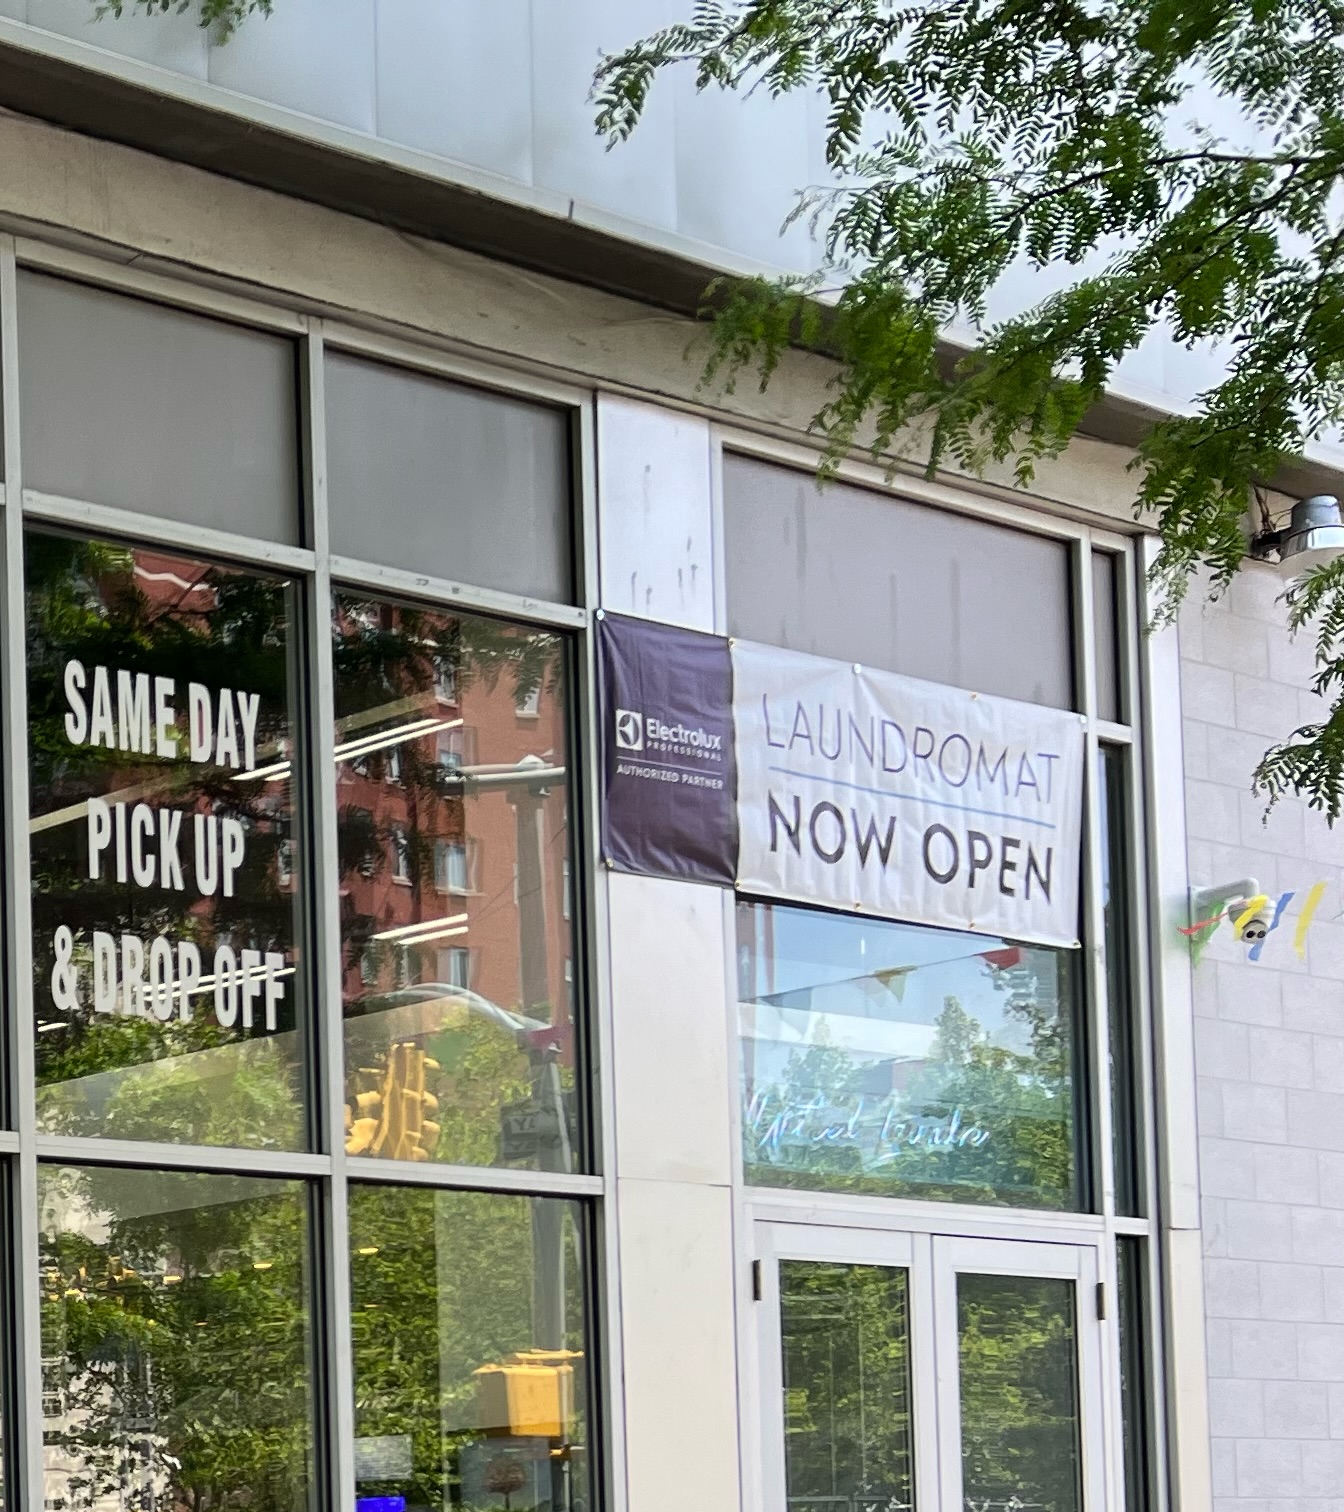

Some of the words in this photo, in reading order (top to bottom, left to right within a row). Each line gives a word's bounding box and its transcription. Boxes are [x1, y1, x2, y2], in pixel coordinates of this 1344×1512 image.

[64, 659, 176, 759] SAME
[190, 682, 260, 771] DAY
[646, 718, 722, 751] Electrolux
[762, 692, 1060, 805] LAUNDROMAT
[616, 764, 680, 783] AUTHORIZED
[681, 773, 724, 790] PARTNER
[88, 798, 184, 892] PICK
[195, 813, 245, 897] UP
[768, 790, 897, 870] NOW
[922, 822, 1054, 906] OPEN
[51, 925, 79, 1011] &
[93, 930, 201, 1023] DROP
[215, 944, 285, 1031] OFF
